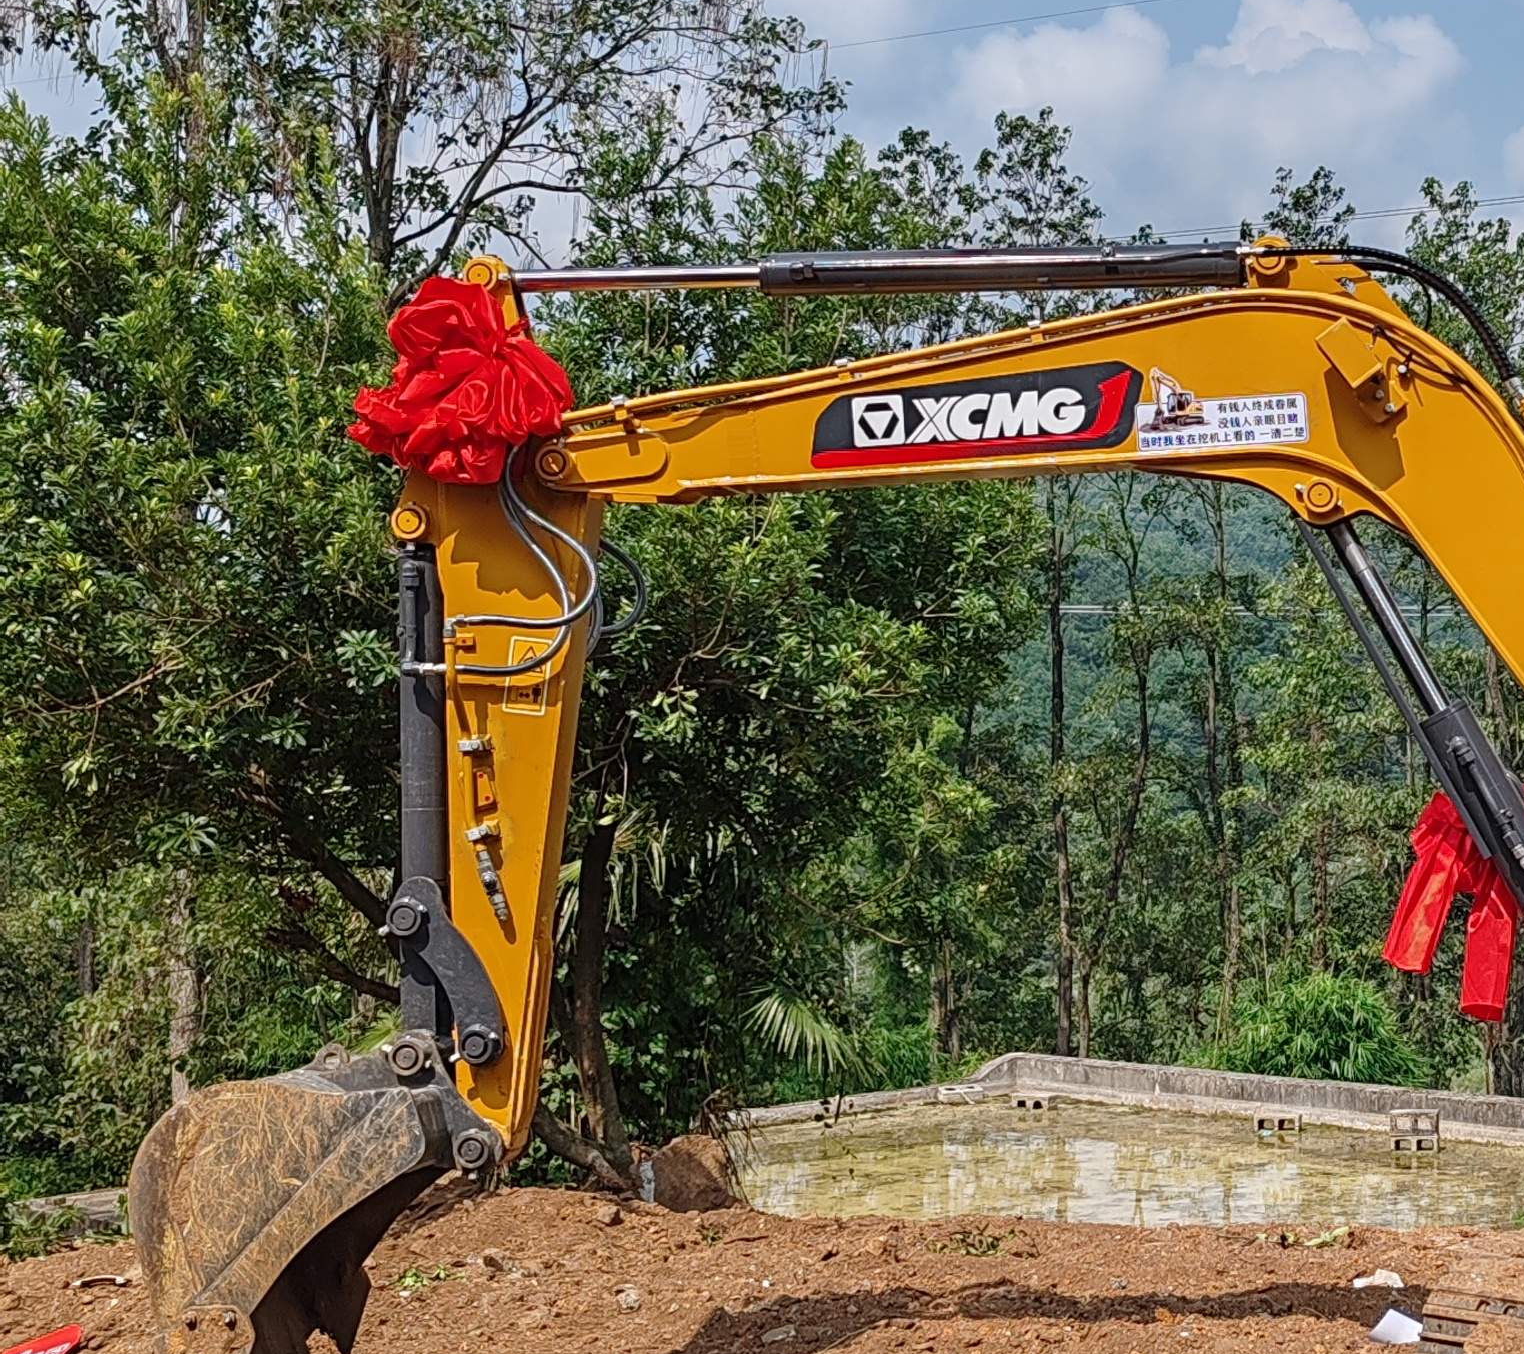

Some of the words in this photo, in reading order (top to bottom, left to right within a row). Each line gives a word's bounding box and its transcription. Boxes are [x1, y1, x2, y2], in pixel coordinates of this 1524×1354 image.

[905, 387, 1085, 444] XCMG
[1217, 397, 1298, 414] 有钱人终成眷属
